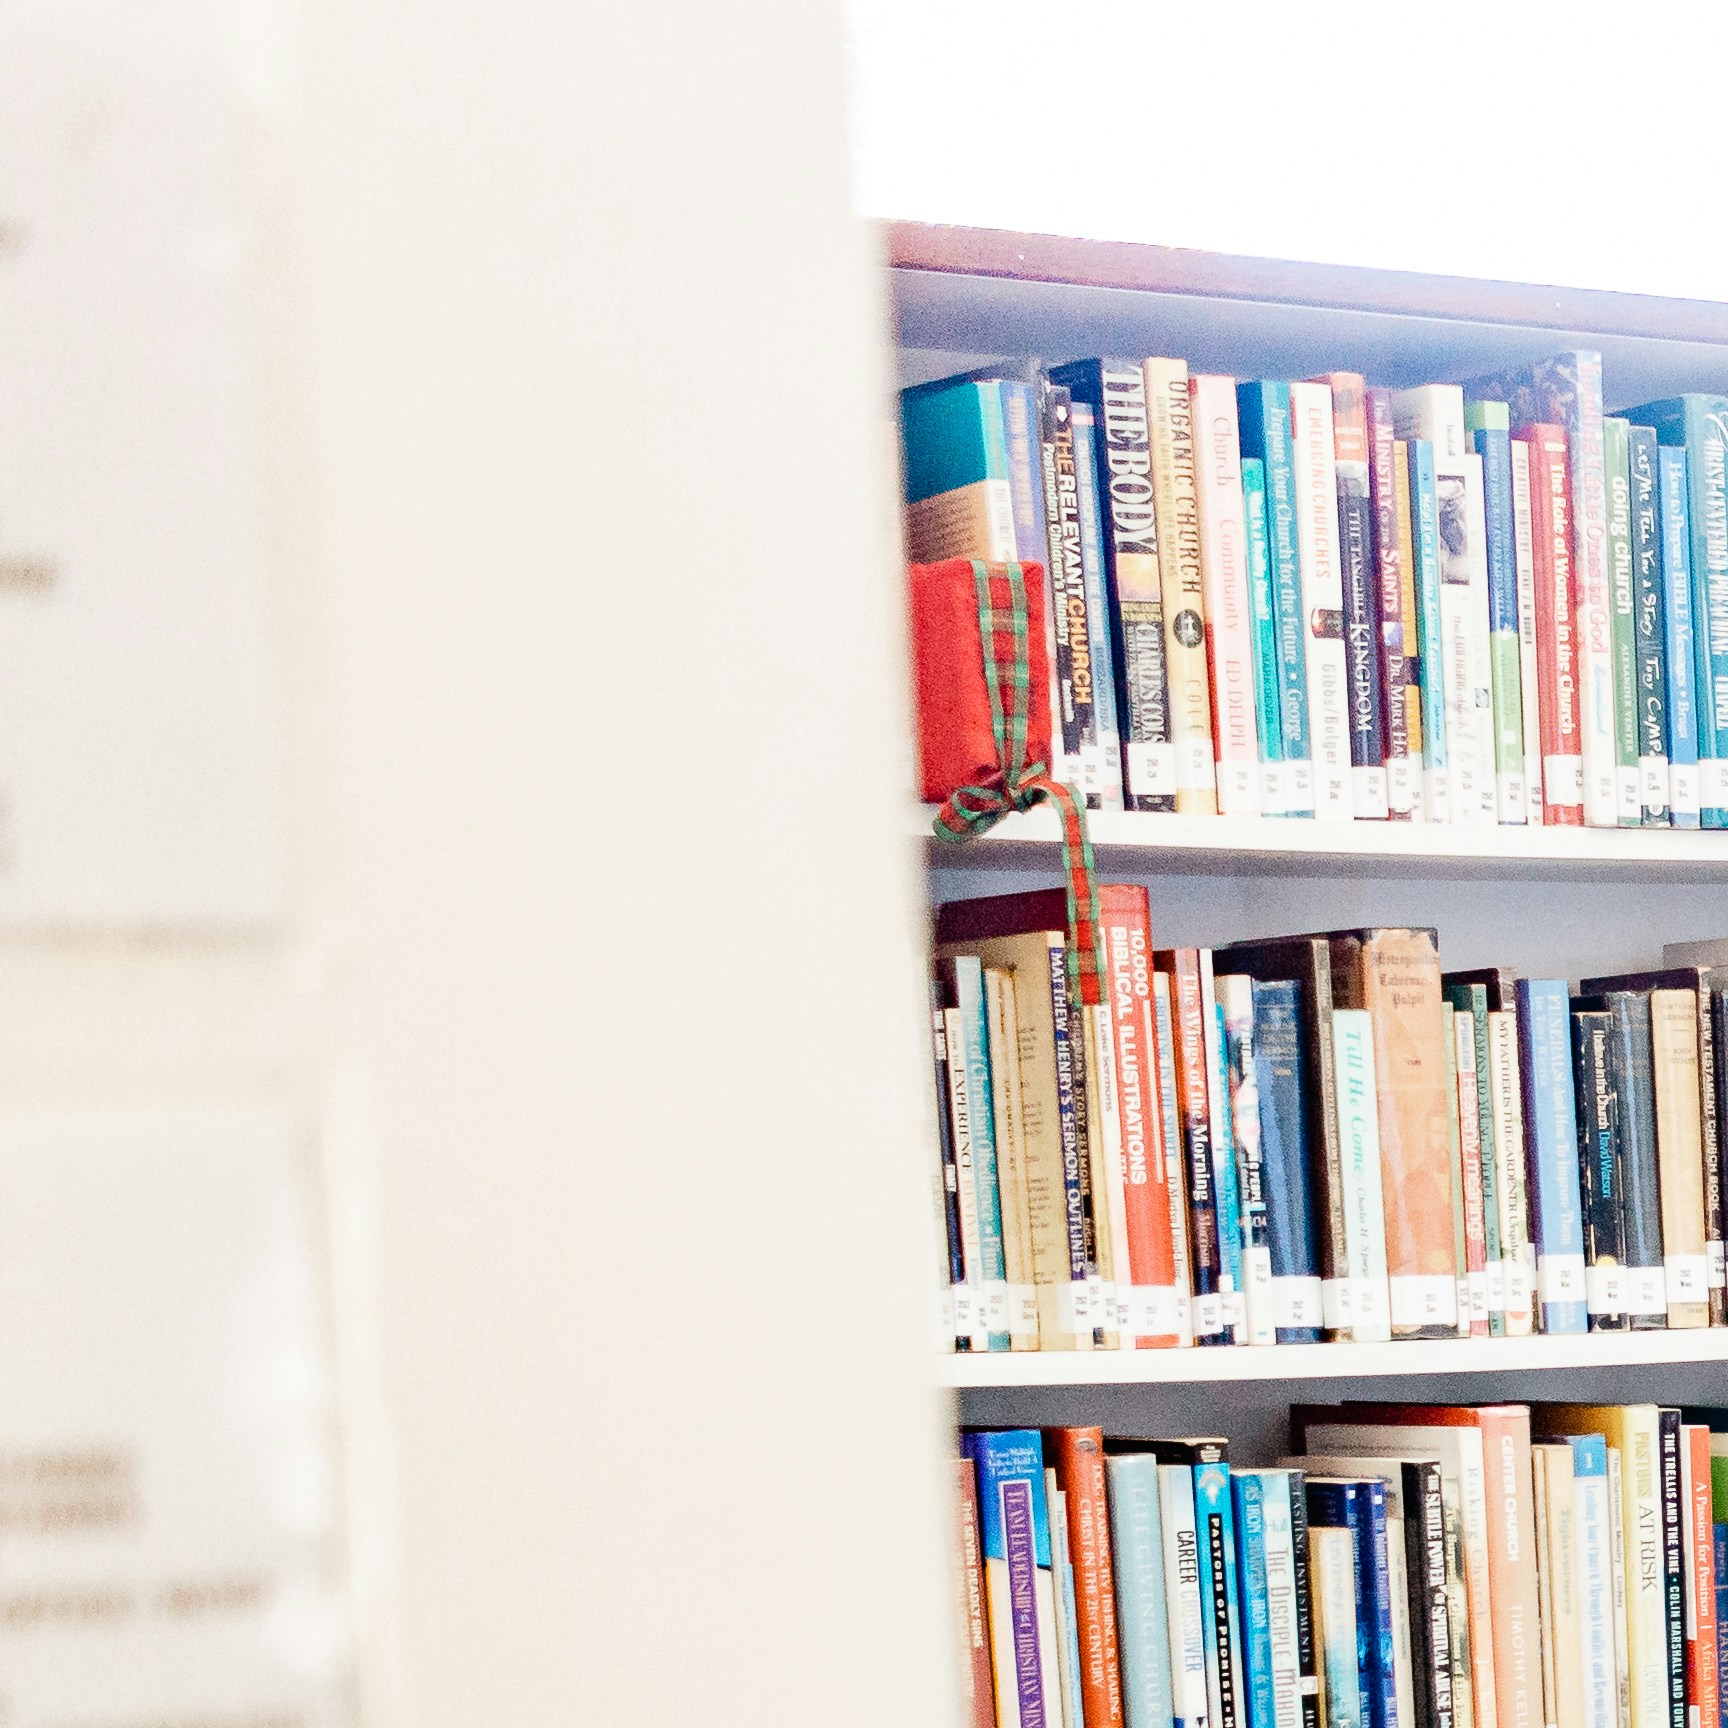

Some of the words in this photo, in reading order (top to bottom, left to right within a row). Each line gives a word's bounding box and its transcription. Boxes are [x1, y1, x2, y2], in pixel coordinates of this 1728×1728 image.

[1169, 381, 1191, 488] ORGANIC
[1107, 452, 1159, 553] BODY
[1550, 463, 1565, 495] The
[1611, 476, 1627, 533] doing
[1174, 494, 1201, 593] CHURCH
[1552, 497, 1568, 533] Role
[1554, 558, 1572, 621] Women
[1614, 539, 1630, 615] church
[1558, 674, 1573, 734] Church
[1051, 952, 1066, 1033] MATTHEW
[1111, 927, 1128, 1020] BIBLICAL
[1130, 928, 1147, 997] 10,000
[1055, 1039, 1071, 1104] HENRY'S
[1118, 1024, 1147, 1186] ILLUSTRATIONS
[1059, 1107, 1076, 1182] SERMON
[1066, 1188, 1084, 1273] OUTLINES
[1501, 1434, 1515, 1493] CENTER
[1663, 1433, 1674, 1454] THE
[1664, 1456, 1676, 1500] TRELLIS
[1505, 1498, 1519, 1562] CHURCH
[1639, 1505, 1655, 1538] AT
[1666, 1503, 1678, 1532] AND
[1667, 1534, 1678, 1553] THE
[1211, 1517, 1223, 1591] PASTORS
[1640, 1543, 1658, 1591] RISK
[1668, 1555, 1680, 1573] VINE
[1216, 1599, 1225, 1618] OF
[1669, 1582, 1681, 1616] COLIN
[1217, 1625, 1231, 1701] PROMISE
[1511, 1605, 1525, 1682] TIMOTHY
[1671, 1619, 1683, 1675] MARSHALL
